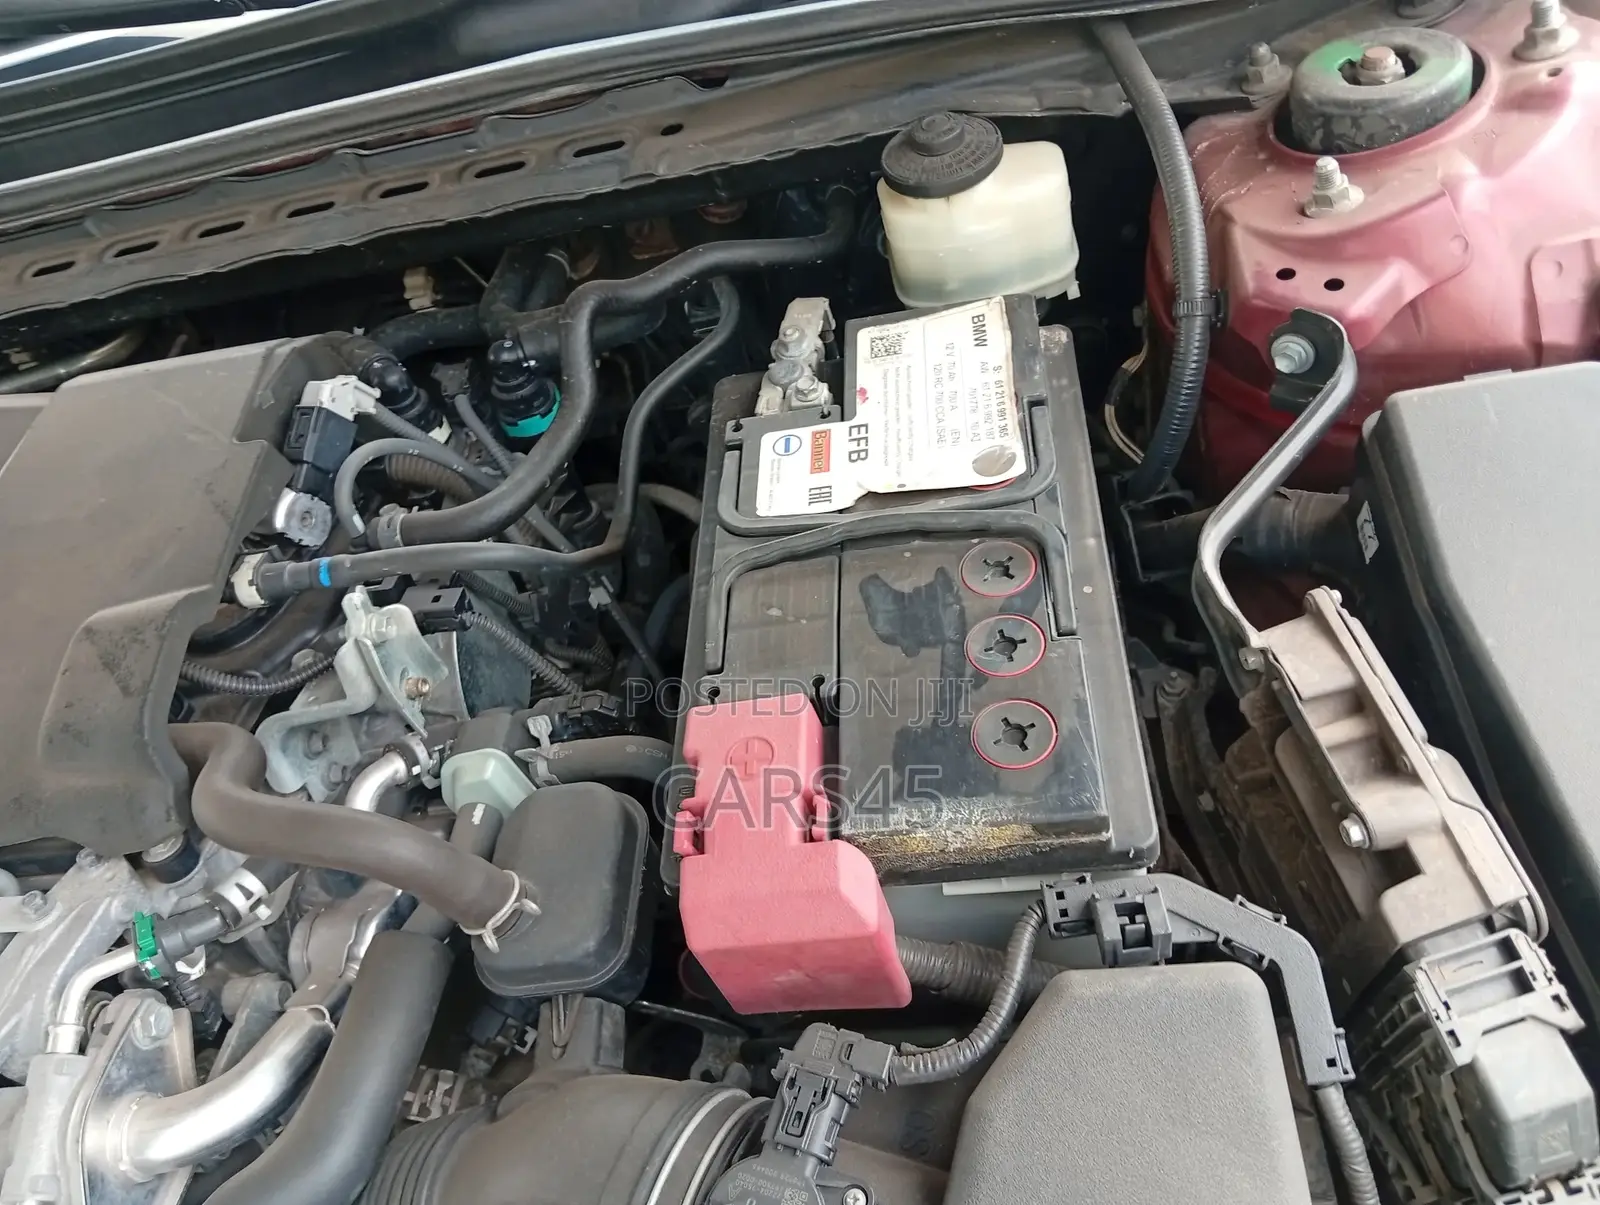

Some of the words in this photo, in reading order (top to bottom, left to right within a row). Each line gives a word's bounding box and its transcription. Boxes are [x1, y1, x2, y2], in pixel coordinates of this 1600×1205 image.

[971, 313, 988, 347] BMW
[995, 390, 1005, 400] 21
[813, 430, 828, 472] Banner
[848, 422, 869, 463] EFB
